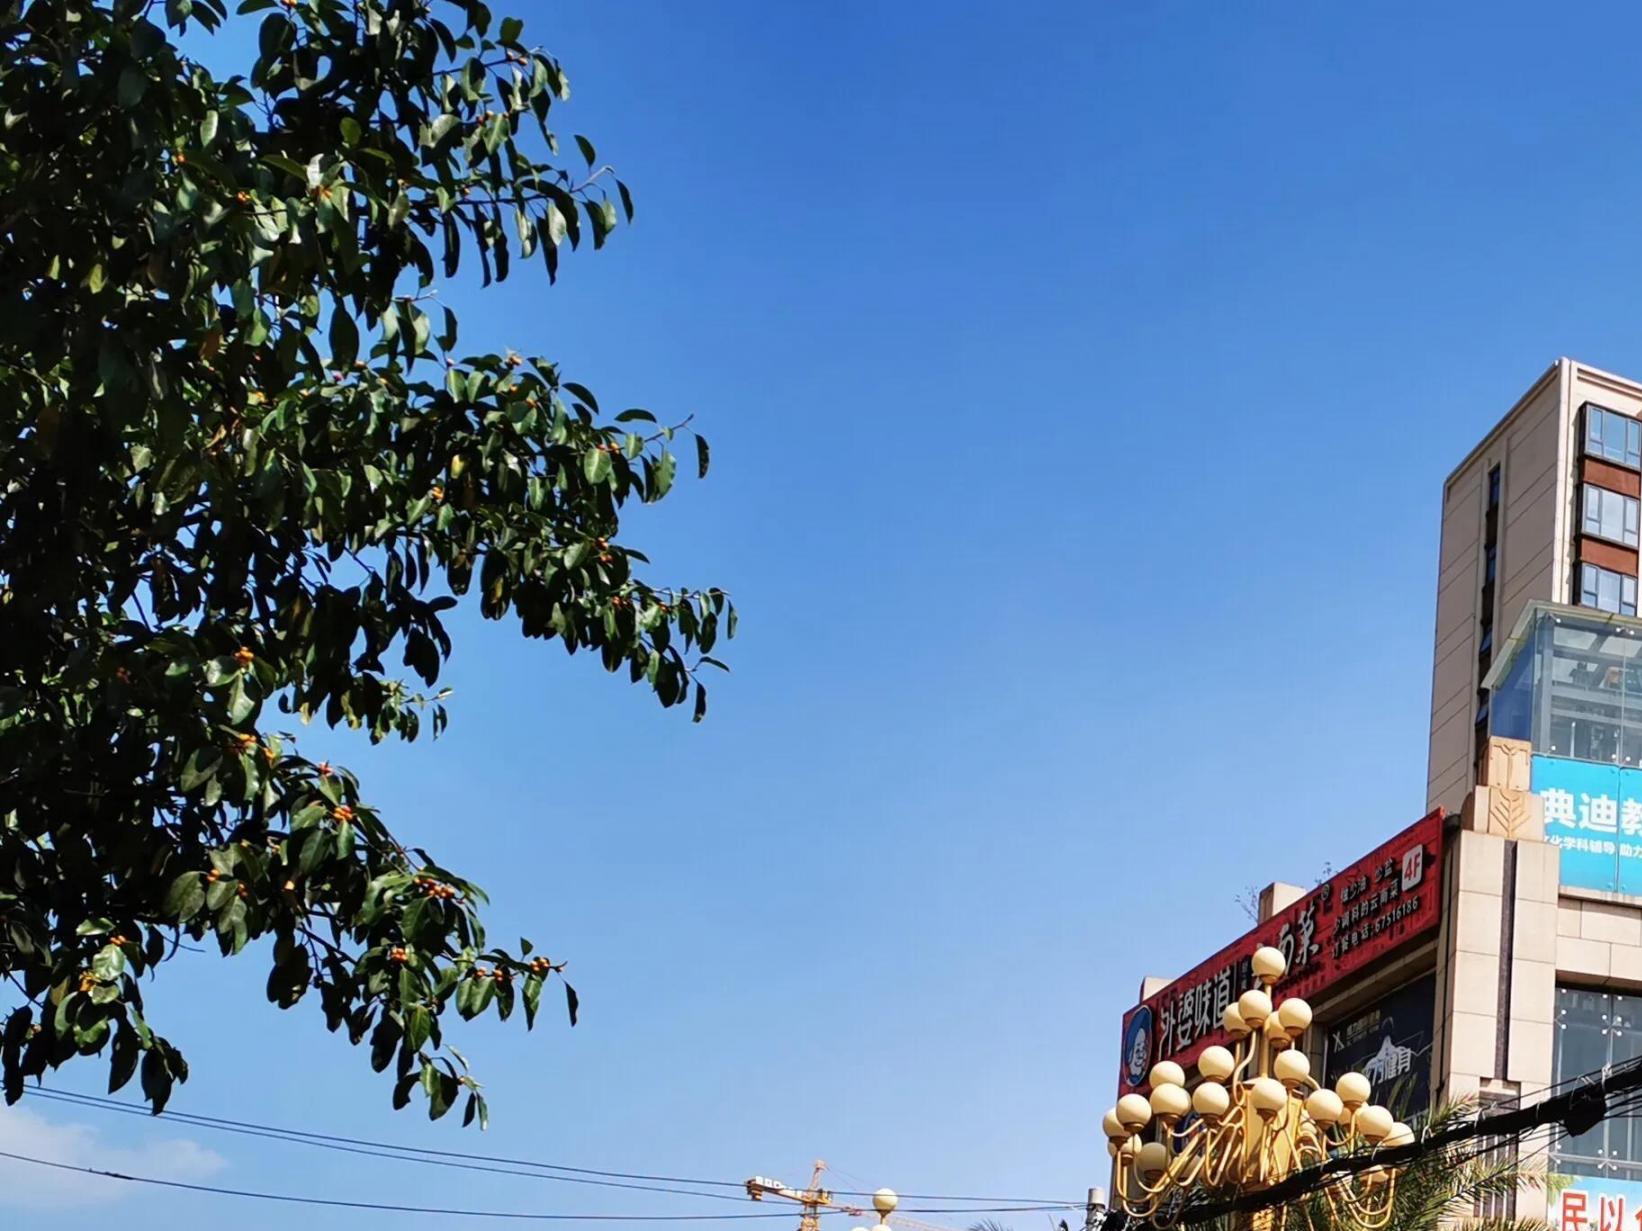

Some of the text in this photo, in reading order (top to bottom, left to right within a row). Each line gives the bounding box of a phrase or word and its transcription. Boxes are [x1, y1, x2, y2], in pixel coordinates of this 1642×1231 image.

[1545, 835, 1616, 856] 化学科辅导
[1403, 852, 1422, 881] 4F
